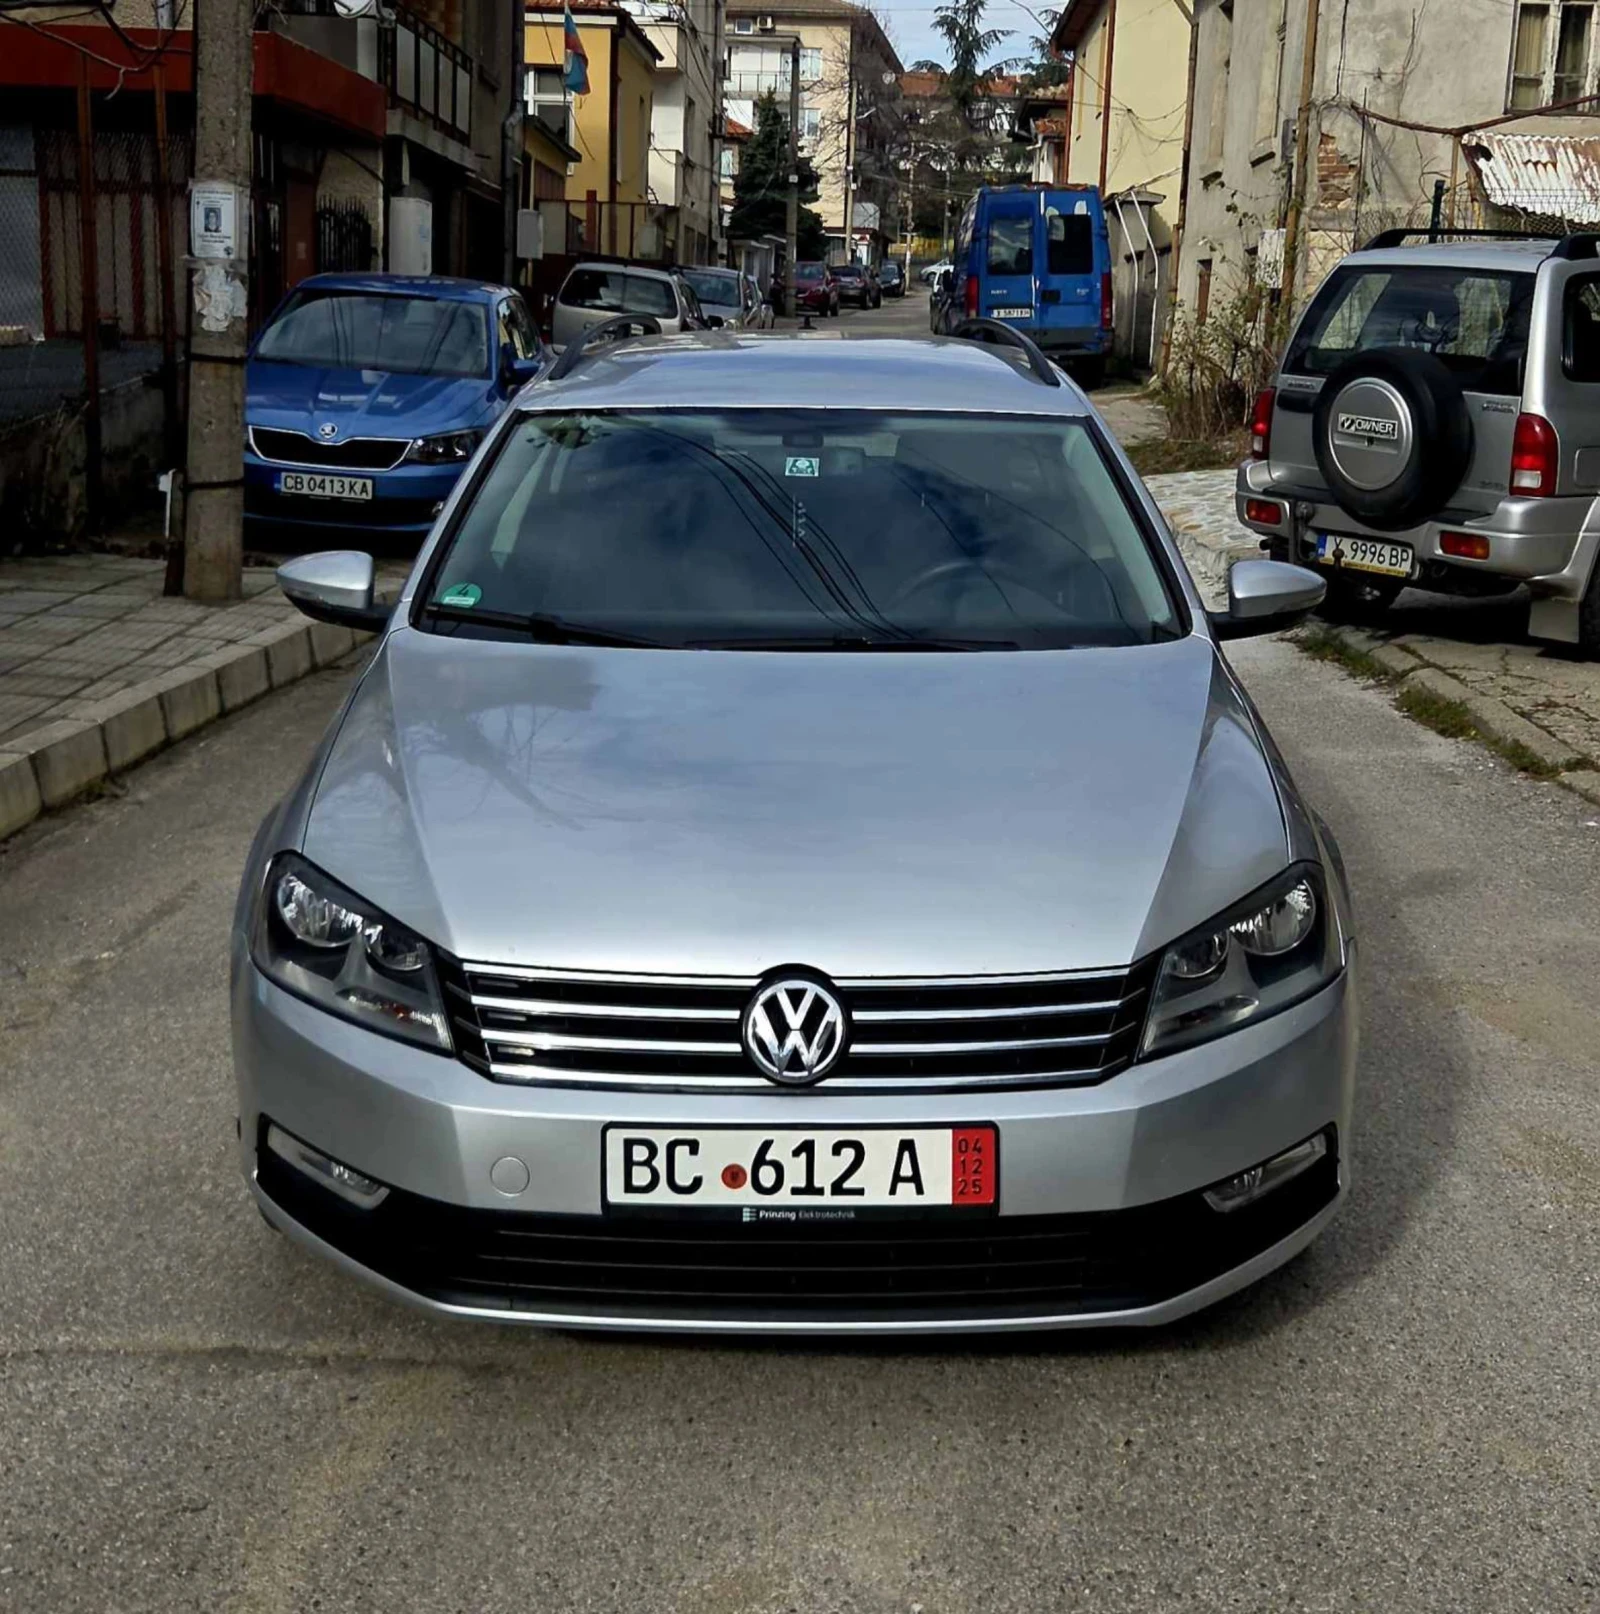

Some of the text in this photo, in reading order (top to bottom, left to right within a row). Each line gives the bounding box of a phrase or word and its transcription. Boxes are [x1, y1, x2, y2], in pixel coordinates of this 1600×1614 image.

[284, 474, 369, 497] CB 0413 KA
[1350, 541, 1386, 565] 9996
[1389, 547, 1410, 568] BP
[957, 1137, 982, 1154] 04
[622, 1137, 925, 1196] BC 612 A
[960, 1157, 983, 1174] 12
[957, 1178, 982, 1196] 25
[759, 1210, 796, 1221] Prinzing
